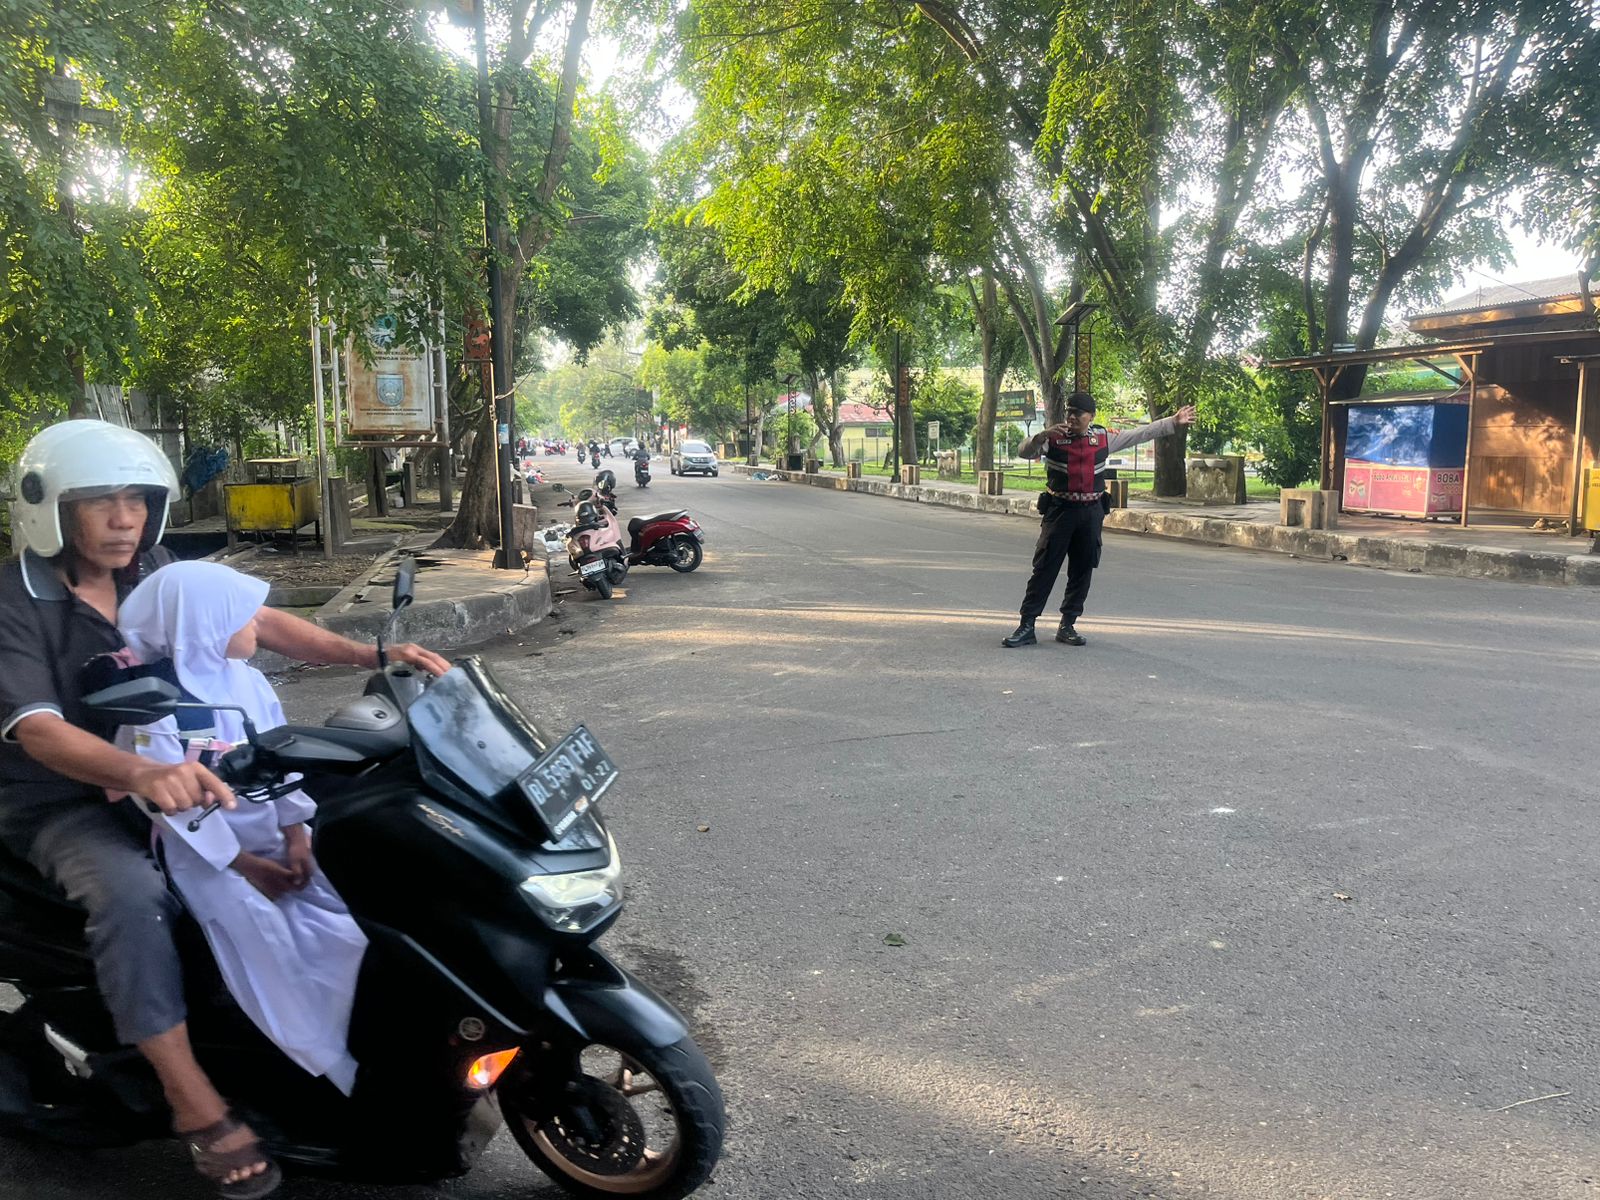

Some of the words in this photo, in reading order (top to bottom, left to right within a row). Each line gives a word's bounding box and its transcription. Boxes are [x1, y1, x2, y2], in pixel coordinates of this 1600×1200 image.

[1437, 473, 1459, 483] BOBA
[528, 778, 553, 805] BL
[566, 732, 595, 765] FAF
